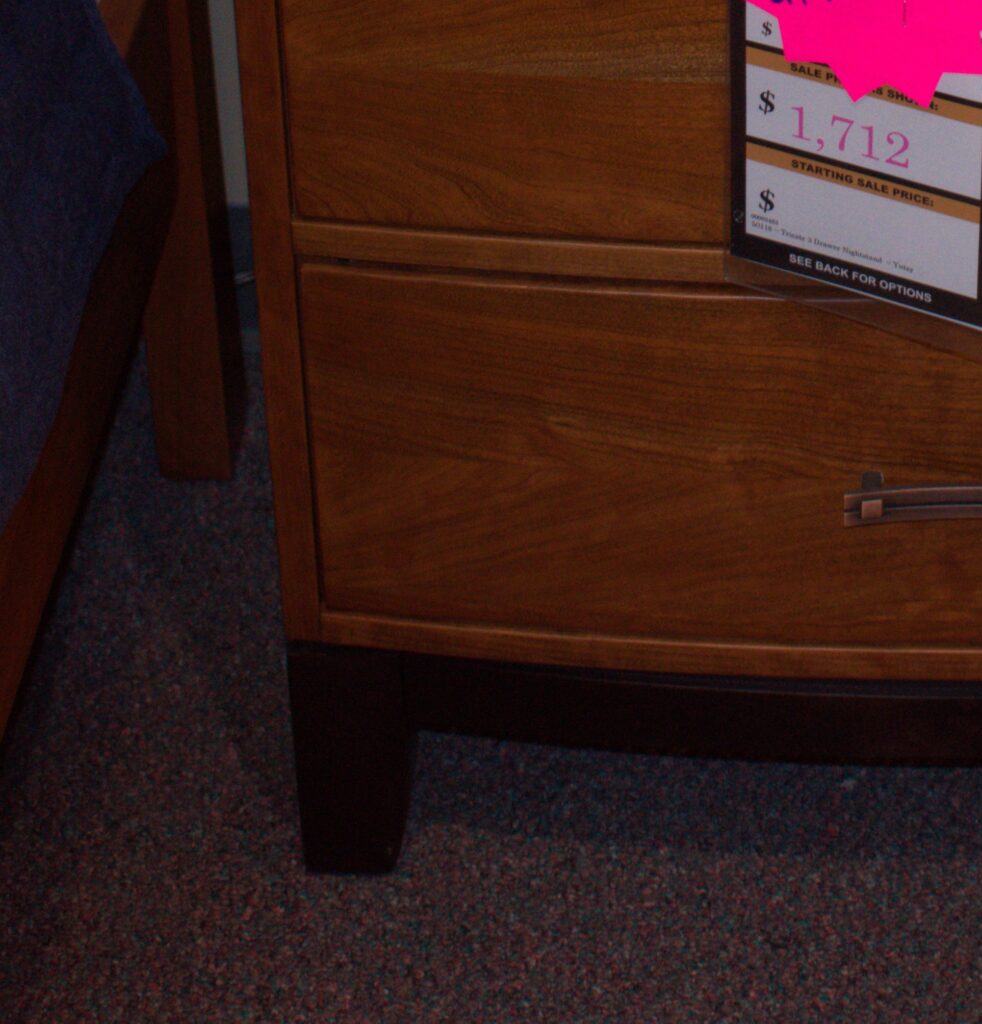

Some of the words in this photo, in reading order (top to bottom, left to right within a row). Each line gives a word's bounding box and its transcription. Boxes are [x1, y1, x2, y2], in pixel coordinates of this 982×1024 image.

[761, 22, 773, 37] $
[790, 62, 822, 79] SALE
[758, 90, 775, 115] $
[791, 106, 910, 169] 1,712
[758, 188, 775, 213] $
[791, 159, 854, 184] STARTING
[857, 178, 889, 194] SALE
[893, 188, 935, 207] PRICE:
[789, 253, 812, 269] SEE
[815, 260, 849, 279] BACK
[852, 270, 877, 287] FOR
[879, 279, 932, 303] OPTIONS
